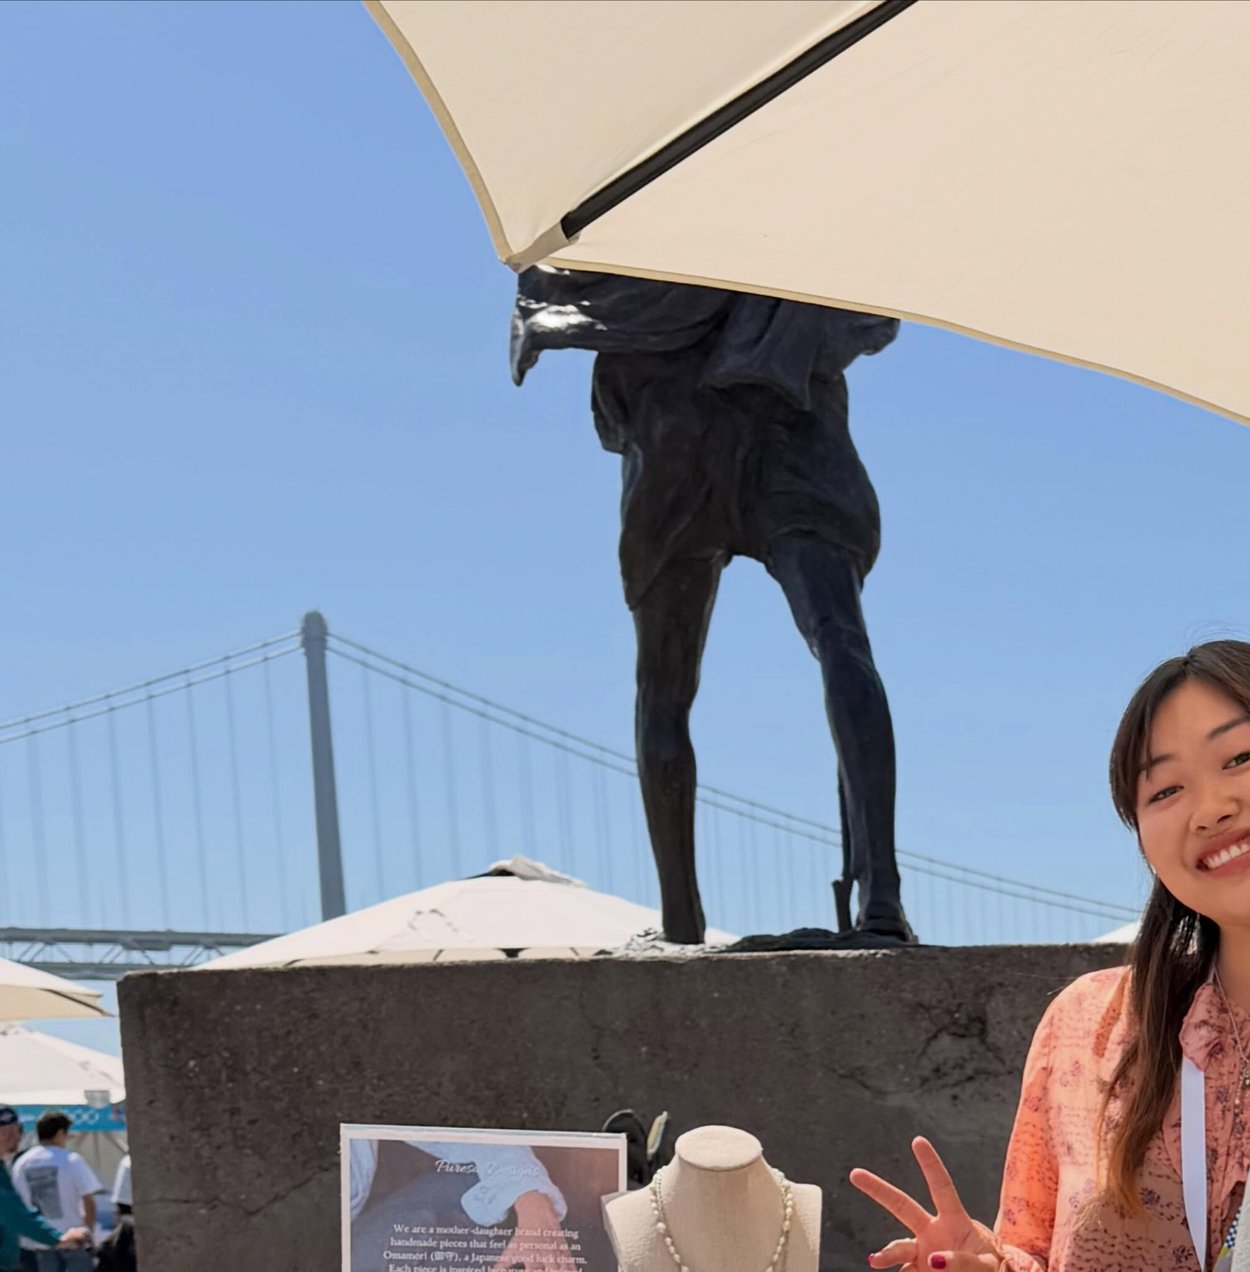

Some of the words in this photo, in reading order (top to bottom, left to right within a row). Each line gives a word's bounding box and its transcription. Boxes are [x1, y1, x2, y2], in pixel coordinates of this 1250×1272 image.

[393, 1224, 409, 1233] We
[515, 1227, 540, 1236] brand
[543, 1229, 579, 1239] creating
[390, 1237, 437, 1247] handmade
[440, 1239, 467, 1249] pieces
[469, 1240, 487, 1248] that
[490, 1240, 506, 1248] feel
[519, 1241, 557, 1251] personal
[383, 1250, 427, 1260] Omamori
[471, 1253, 508, 1264] Japanese
[536, 1254, 555, 1263] luck
[389, 1264, 411, 1272] Each
